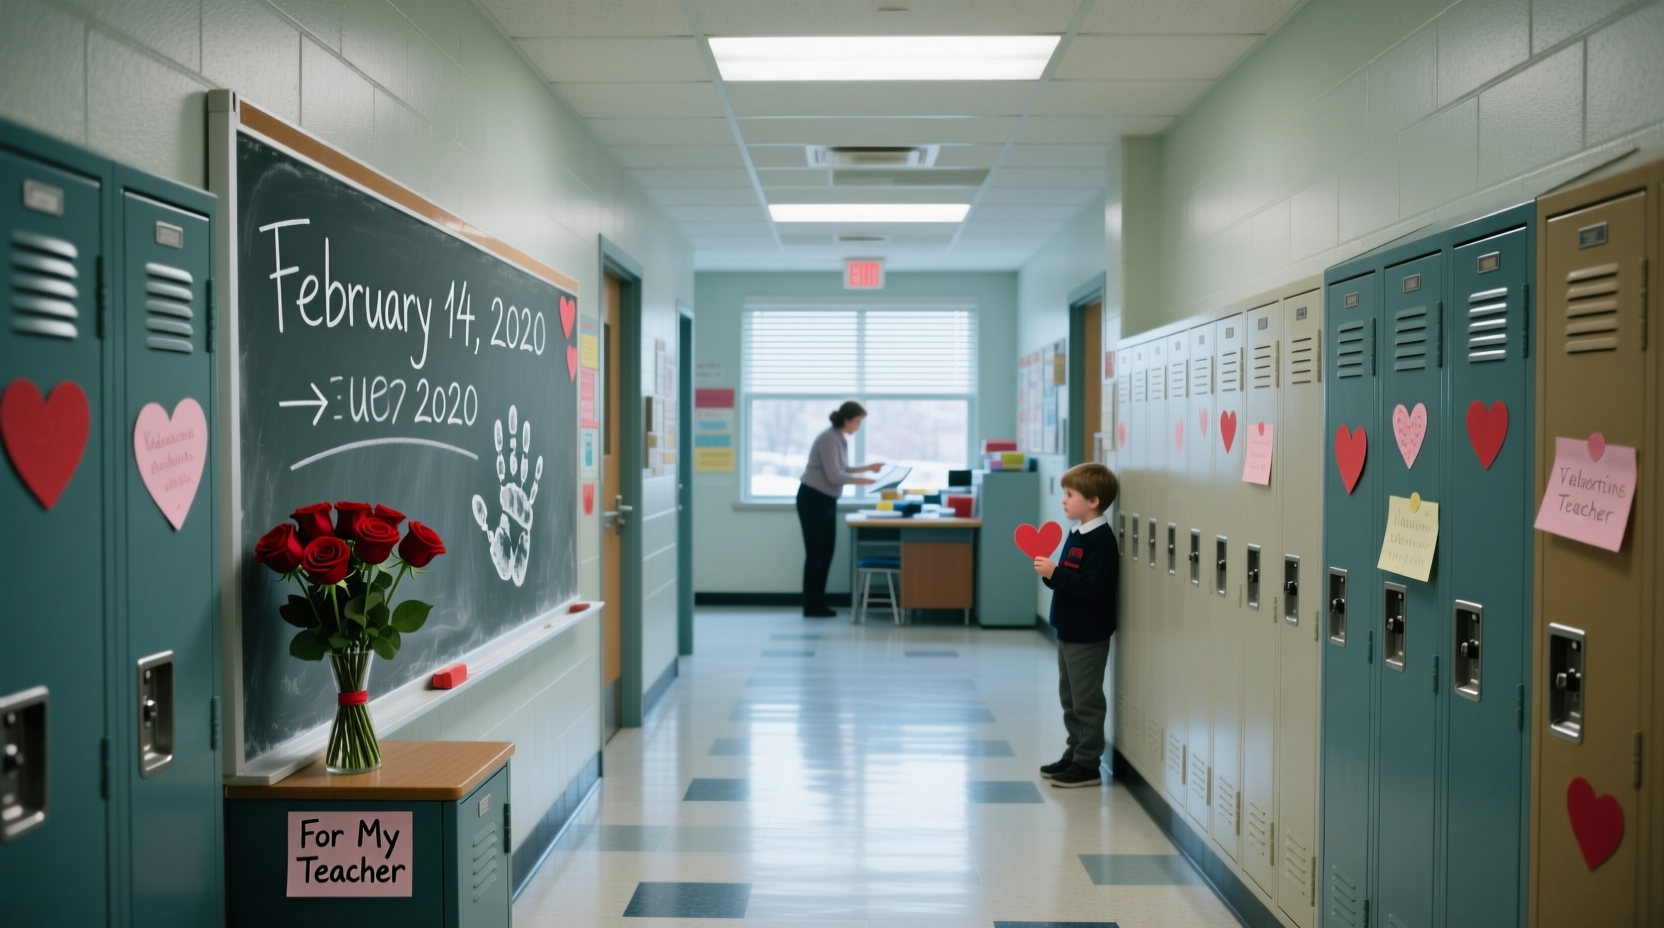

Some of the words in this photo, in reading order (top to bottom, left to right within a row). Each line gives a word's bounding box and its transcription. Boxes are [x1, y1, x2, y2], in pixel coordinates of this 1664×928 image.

[259, 218, 432, 370] February
[444, 280, 480, 355] 14,
[490, 297, 546, 356] 2020
[414, 378, 478, 427] 2020
[1558, 494, 1615, 524] Teacher
[301, 818, 345, 849] For
[357, 818, 400, 860] My
[296, 856, 406, 884] Teacher
